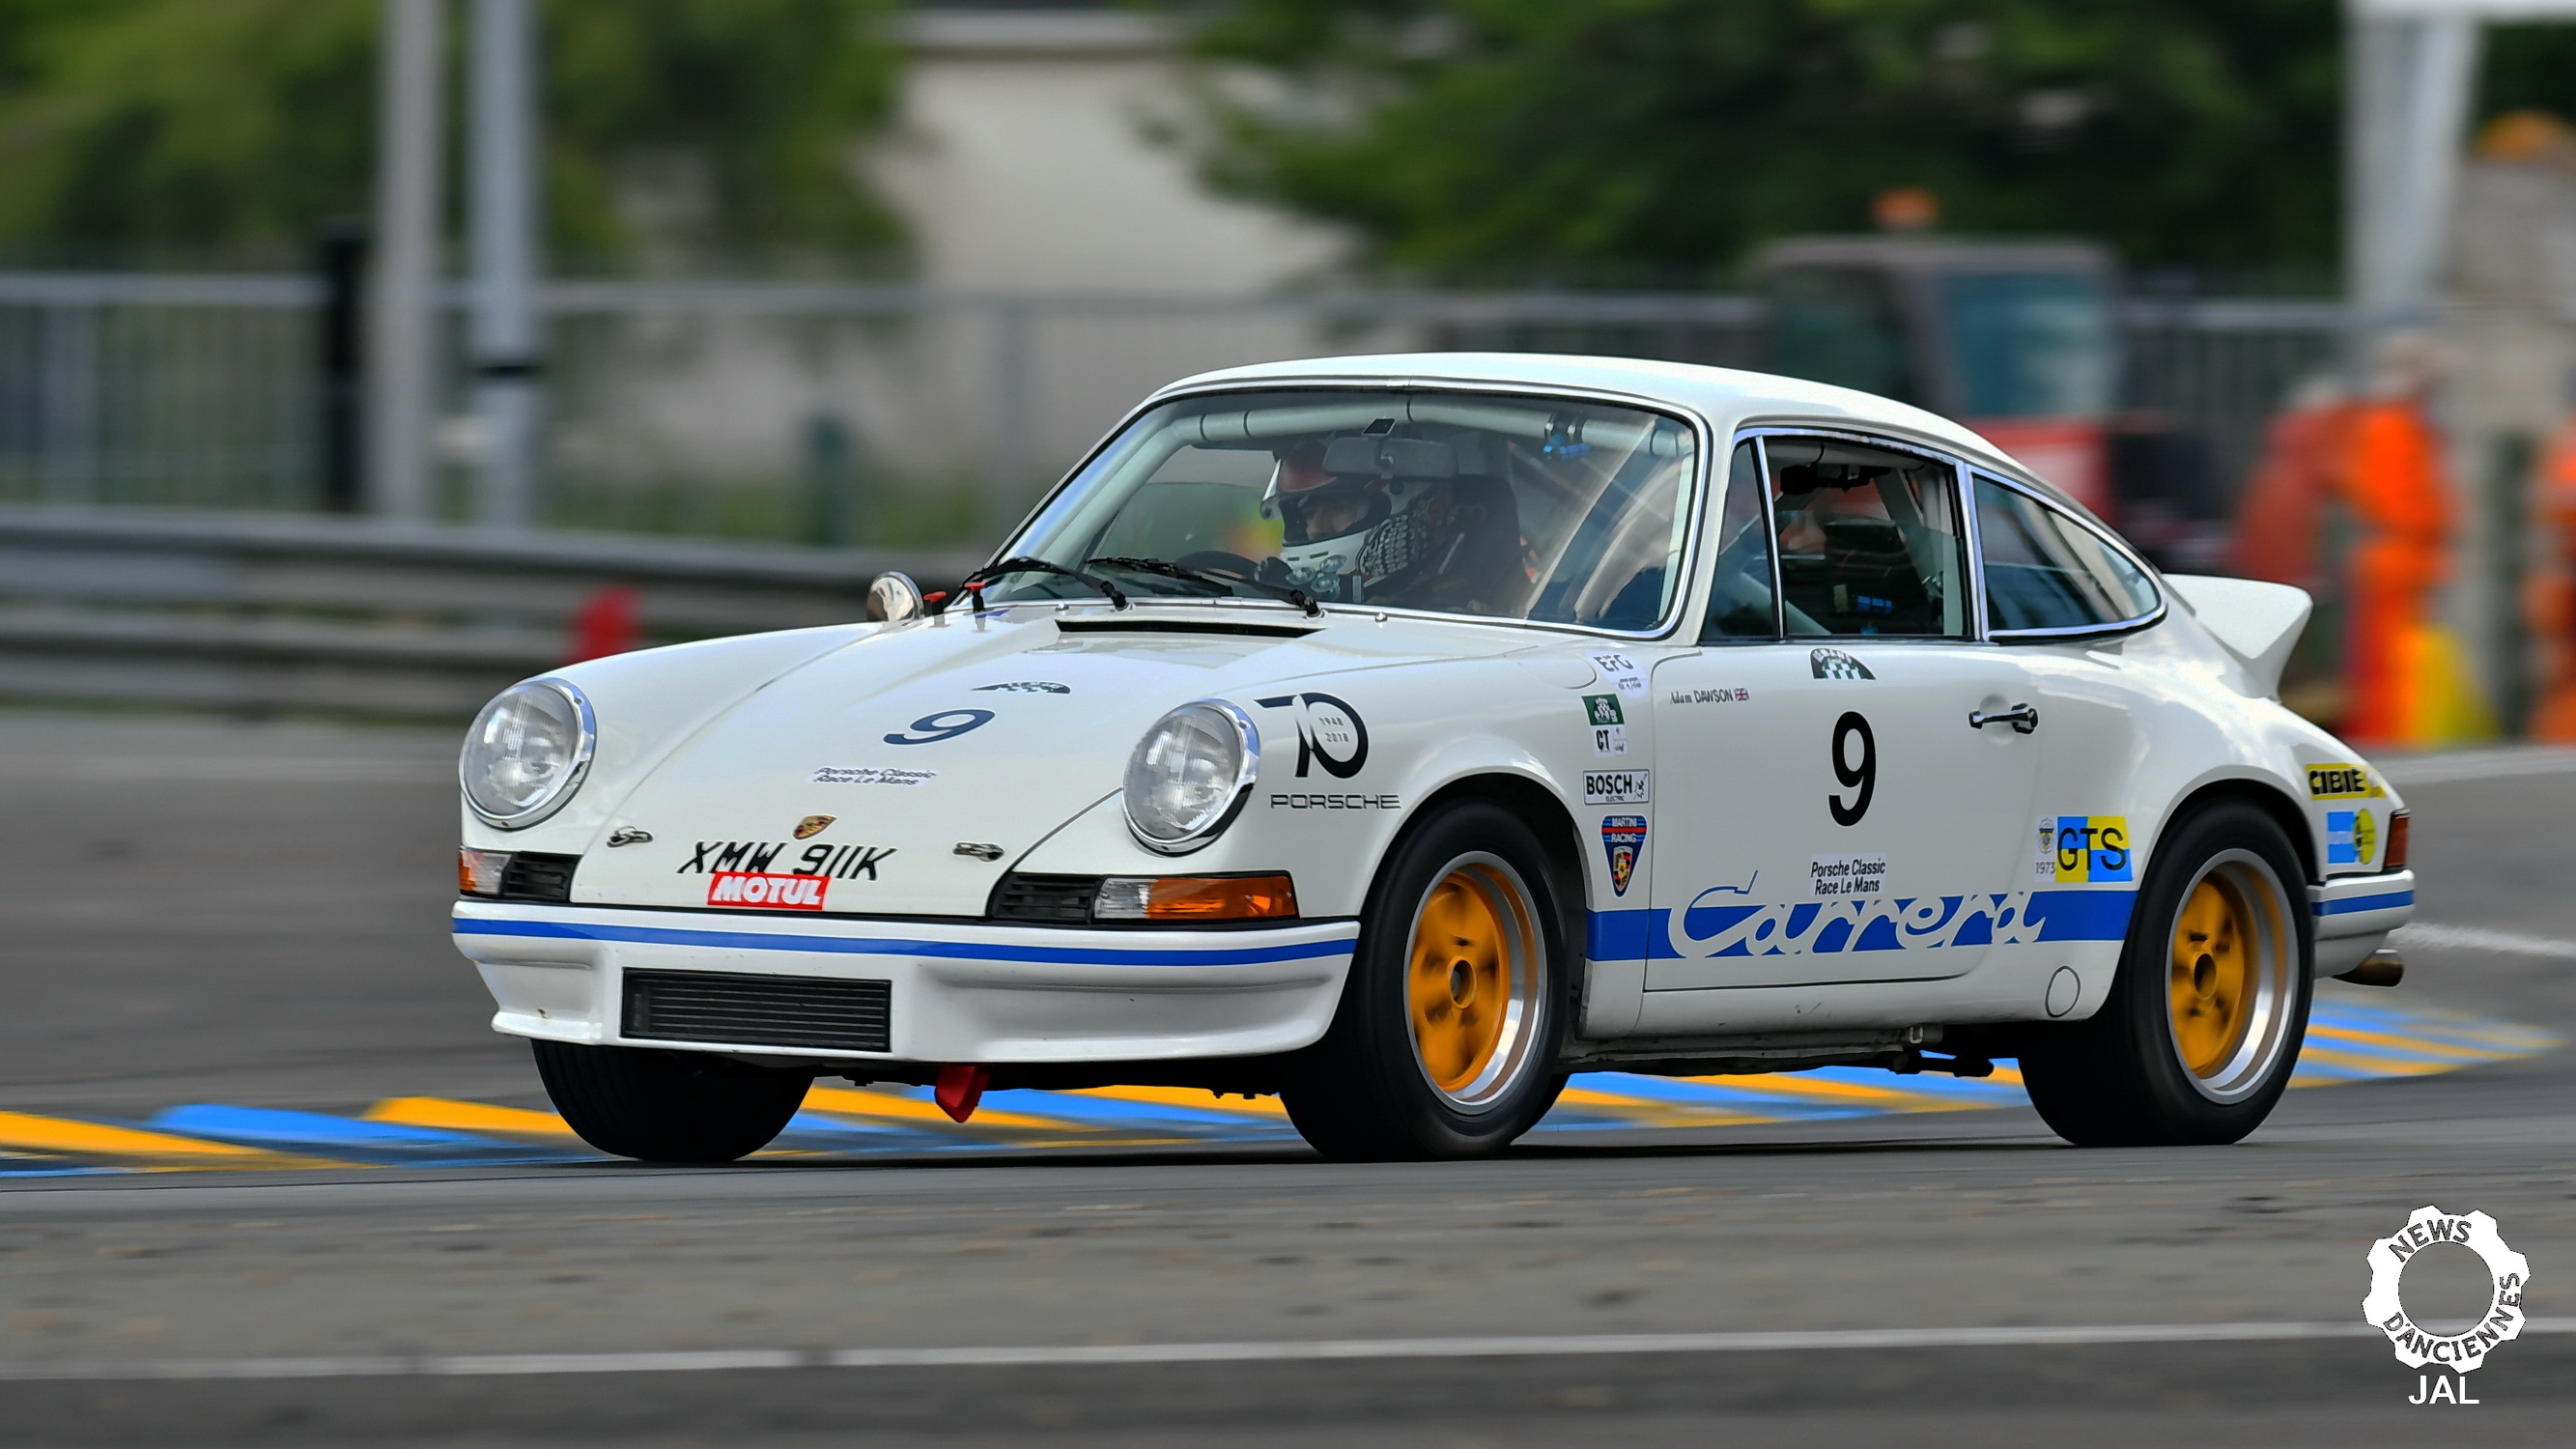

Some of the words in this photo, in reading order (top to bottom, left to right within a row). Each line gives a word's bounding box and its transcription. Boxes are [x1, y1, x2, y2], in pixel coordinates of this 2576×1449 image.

[1670, 691, 1692, 704] Adam
[1693, 689, 1734, 704] DAWSON
[883, 709, 996, 745] 9
[1324, 732, 1349, 743] 2018
[1828, 711, 1877, 826] 9
[812, 775, 853, 783] Race
[854, 775, 875, 783] Le
[874, 776, 920, 785] Mans
[1586, 774, 1632, 795] BOSCH
[1270, 794, 1401, 810] PORSCHE
[1611, 817, 1637, 827] MARTINI
[1611, 833, 1637, 843] RACING
[2057, 827, 2127, 871] GTS
[676, 841, 787, 873] XMW
[792, 844, 897, 880] 911K
[1810, 861, 1850, 878] Porsche
[1852, 858, 1886, 876] Classic
[2035, 862, 2055, 874] 1973
[712, 876, 822, 905] MOTUL
[1815, 878, 1839, 895] Race
[1840, 877, 1853, 894] Le
[1854, 876, 1881, 893] Mans
[1668, 869, 2047, 958] Carrera
